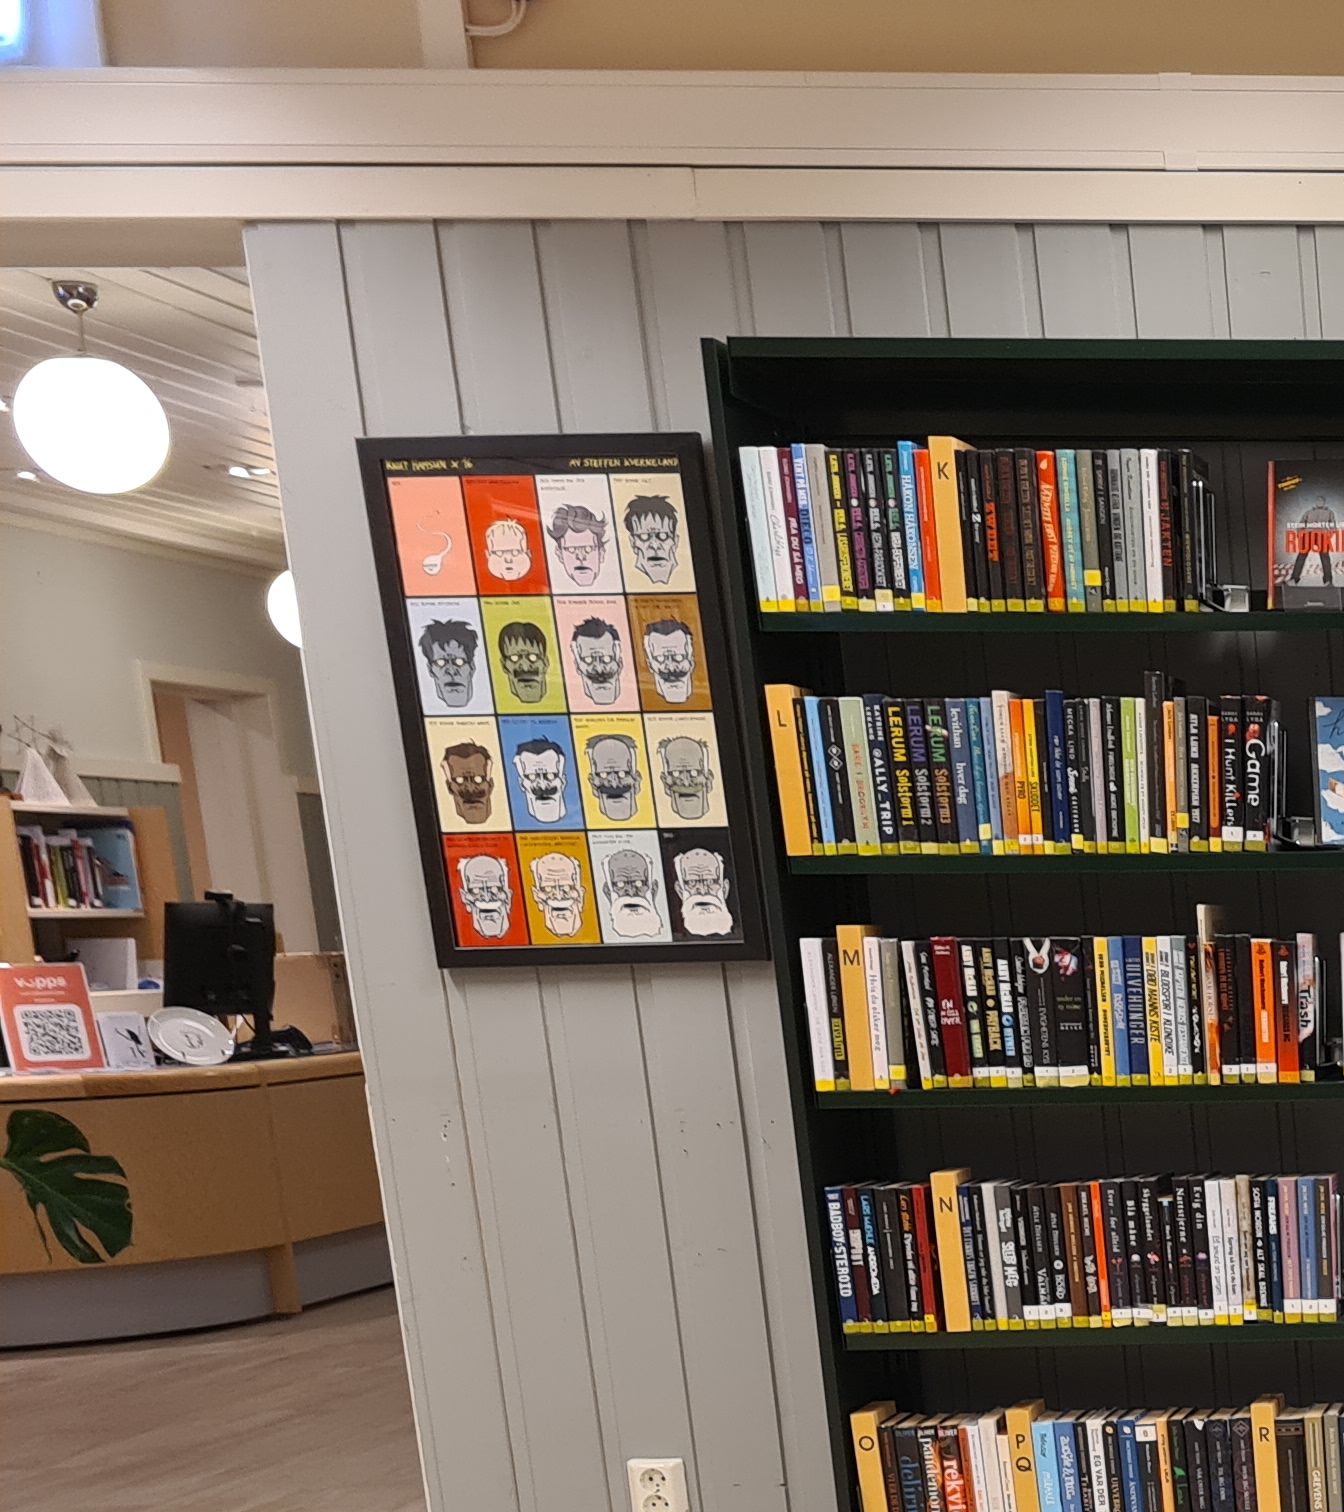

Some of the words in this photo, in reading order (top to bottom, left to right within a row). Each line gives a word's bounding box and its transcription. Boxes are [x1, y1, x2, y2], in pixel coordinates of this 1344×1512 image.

[938, 462, 949, 480] K
[901, 475, 914, 512] HÅKON
[789, 517, 798, 534] FRA
[790, 537, 799, 549] DU
[792, 552, 801, 564] SÅ
[795, 565, 803, 584] MEG
[777, 710, 787, 727] L
[950, 708, 963, 748] levithan
[888, 707, 906, 762] LERUM
[907, 706, 926, 762] LERUM
[927, 706, 945, 762] LERUM
[956, 763, 966, 785] hver
[1245, 738, 1266, 807] Game
[872, 748, 893, 835] @ALLY_TRIP
[896, 769, 911, 817] Solstorm
[915, 769, 931, 817] Solstorm
[934, 769, 951, 818] Solstorm
[957, 786, 968, 804] dag
[842, 949, 861, 966] M
[868, 974, 880, 993] Hvis
[870, 994, 880, 1004] du
[1125, 964, 1145, 1044] ULVEHUNGER
[1148, 989, 1159, 1018] MANNS
[1299, 985, 1312, 1028] Trash
[1149, 1020, 1160, 1043] KISTE
[871, 1033, 882, 1052] meg
[939, 1197, 952, 1213] N
[1191, 1186, 1203, 1208] Evig
[1141, 1188, 1154, 1241] Skyggelandet
[1174, 1187, 1187, 1243] Nattstjerne
[1195, 1211, 1204, 1229] din
[1129, 1220, 1139, 1246] måne
[859, 1436, 874, 1451] O
[1016, 1434, 1026, 1449] P
[1259, 1427, 1270, 1442] R
[1016, 1457, 1032, 1472] Q
[1094, 1455, 1103, 1467] EG
[1095, 1469, 1104, 1487] VAR
[1096, 1489, 1106, 1506] DER
[1313, 1470, 1323, 1510] GREVENS
